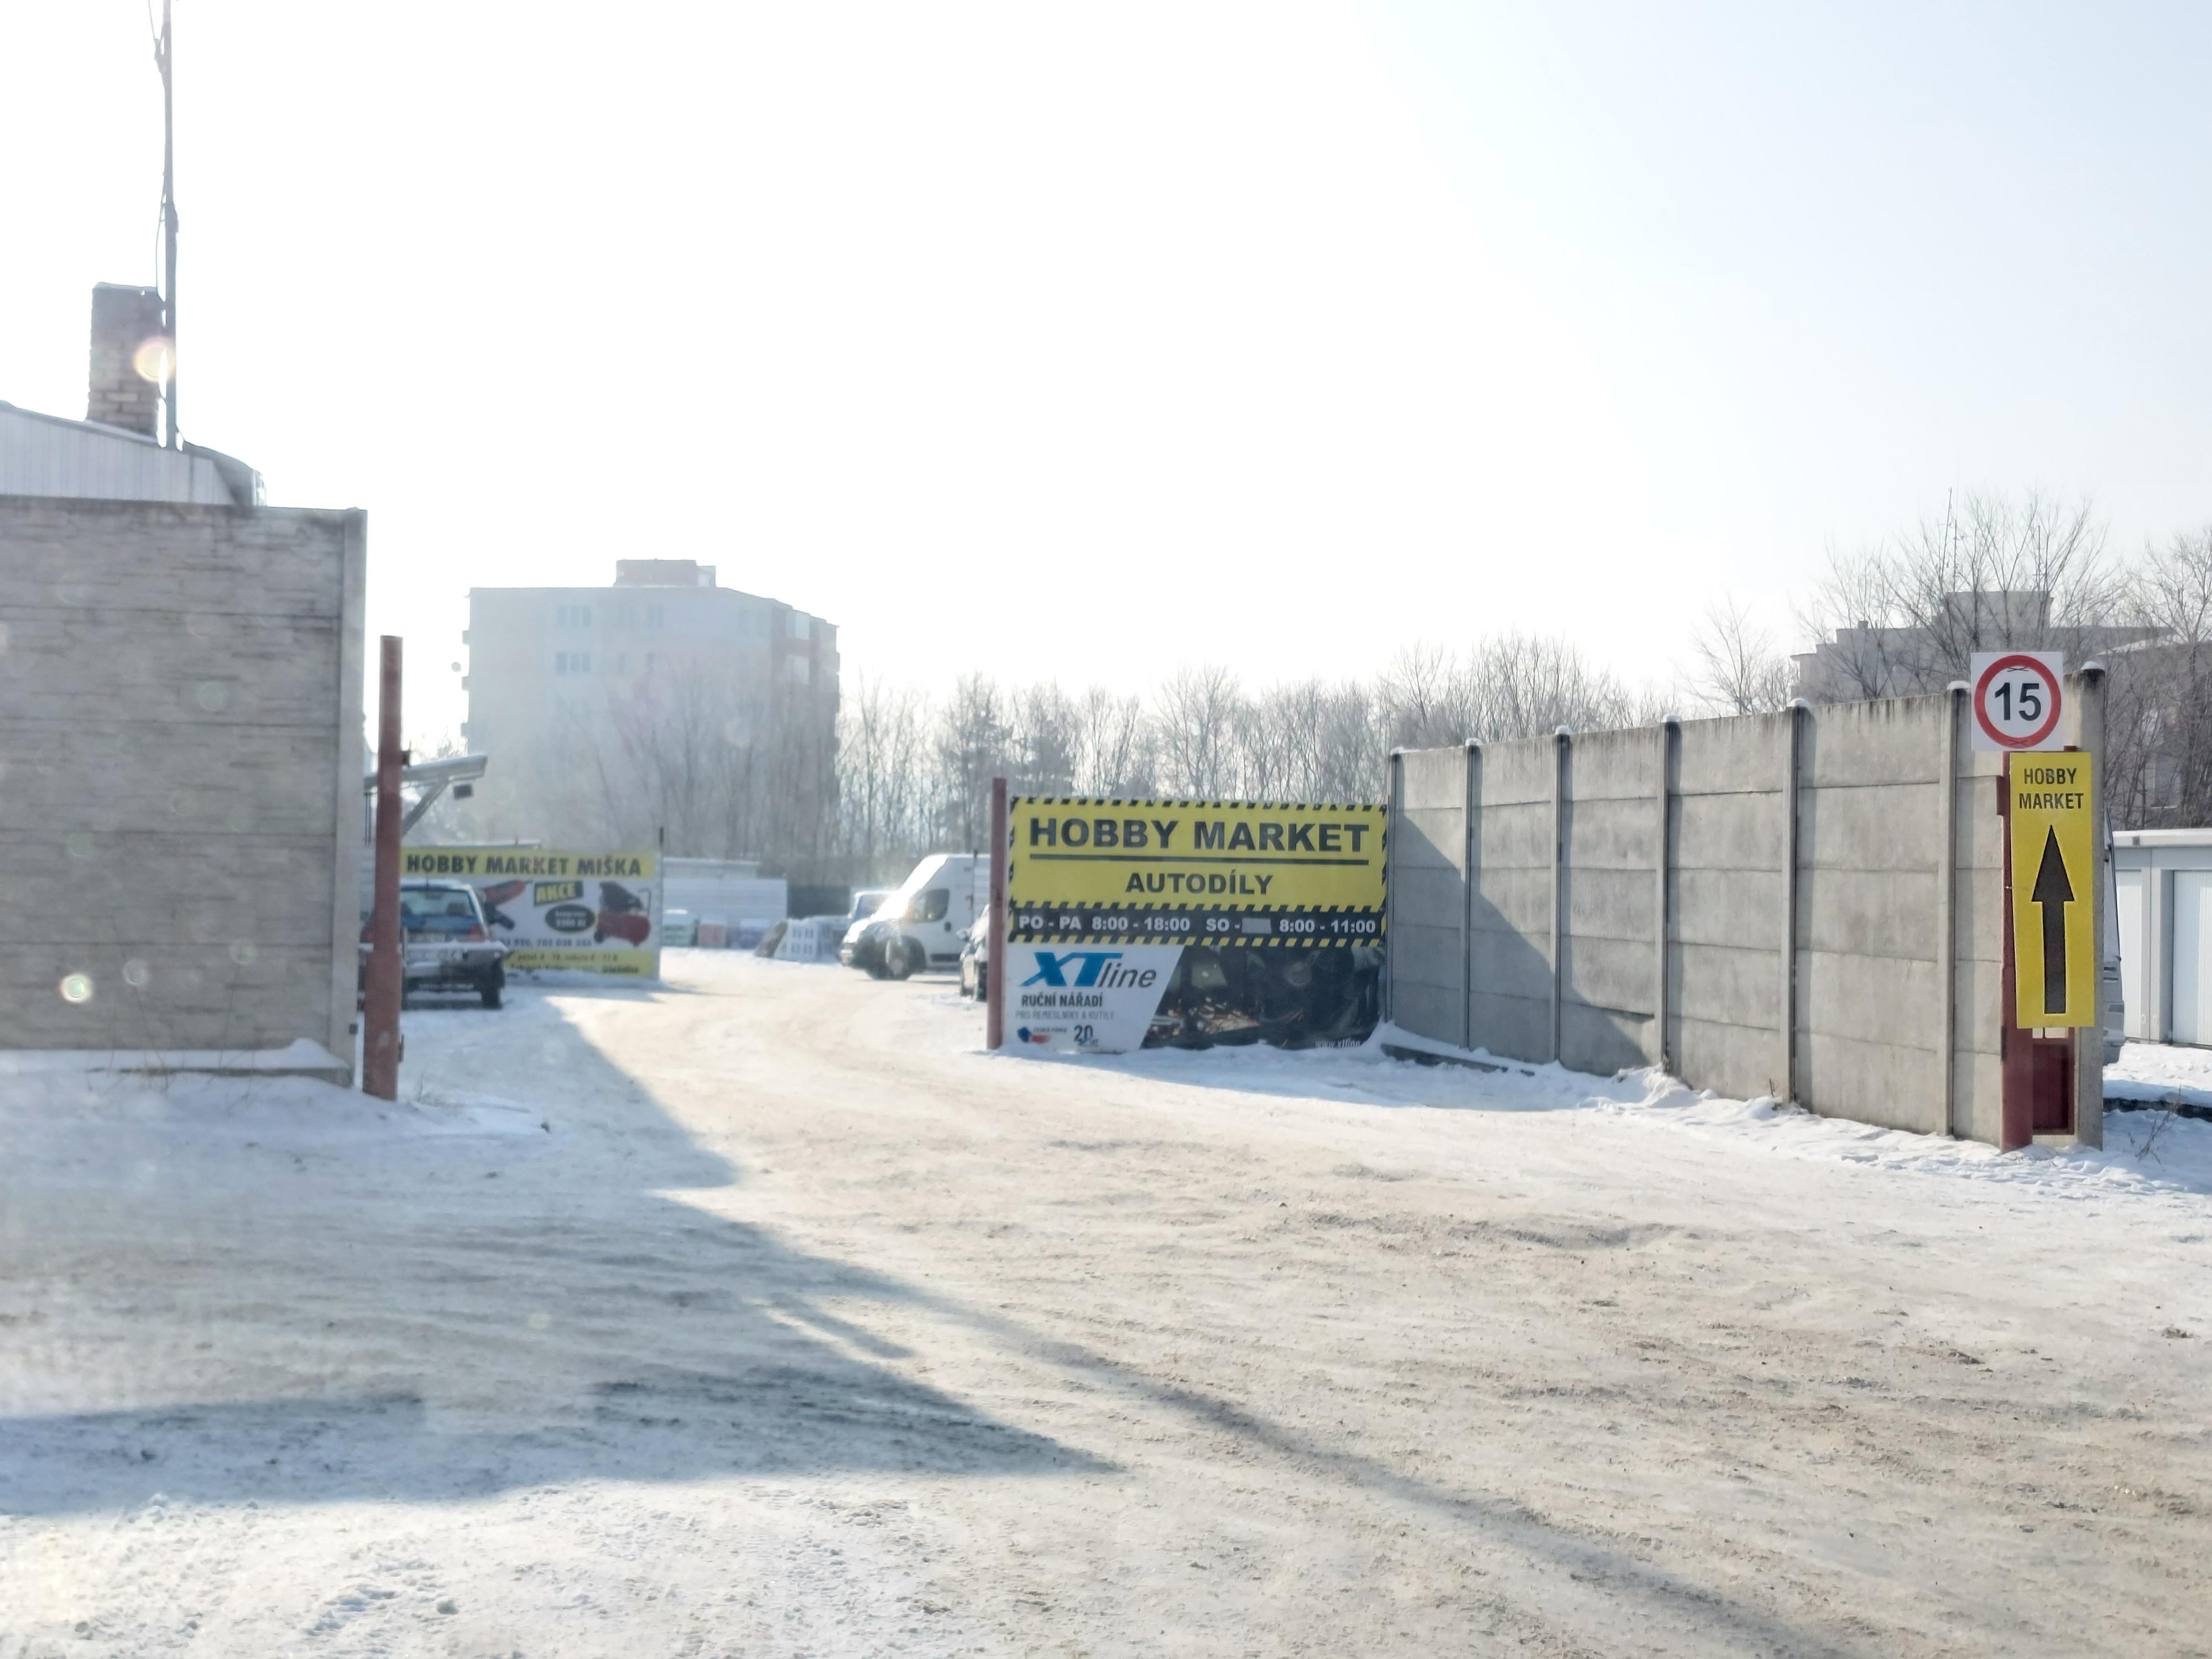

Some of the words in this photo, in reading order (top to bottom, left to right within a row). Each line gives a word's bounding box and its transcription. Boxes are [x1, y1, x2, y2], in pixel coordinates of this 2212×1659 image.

[1995, 682, 2041, 721] 15
[2023, 768, 2077, 785] HOBBY
[2019, 792, 2084, 809] MARKET
[1029, 817, 1178, 848] HOBBY
[1193, 821, 1369, 852] MARKET
[407, 854, 478, 873] HOBBY
[486, 855, 570, 874] MARKET
[577, 854, 641, 876] MIŠKA
[1125, 869, 1273, 895] AUTODÍLY
[536, 883, 575, 903] AKCE
[1019, 916, 1043, 930] PO
[1059, 917, 1082, 930] PA
[1091, 917, 1128, 931] 8:00
[1144, 917, 1190, 931] 18:00
[1206, 919, 1230, 932] SO
[1279, 920, 1315, 933] 8:00
[1331, 920, 1376, 933] 11:00
[1020, 951, 1156, 989] XTline
[1021, 992, 1056, 1006] RUČNÍ
[1060, 992, 1103, 1006] NÁŘADÍ
[1073, 1025, 1093, 1043] 20
